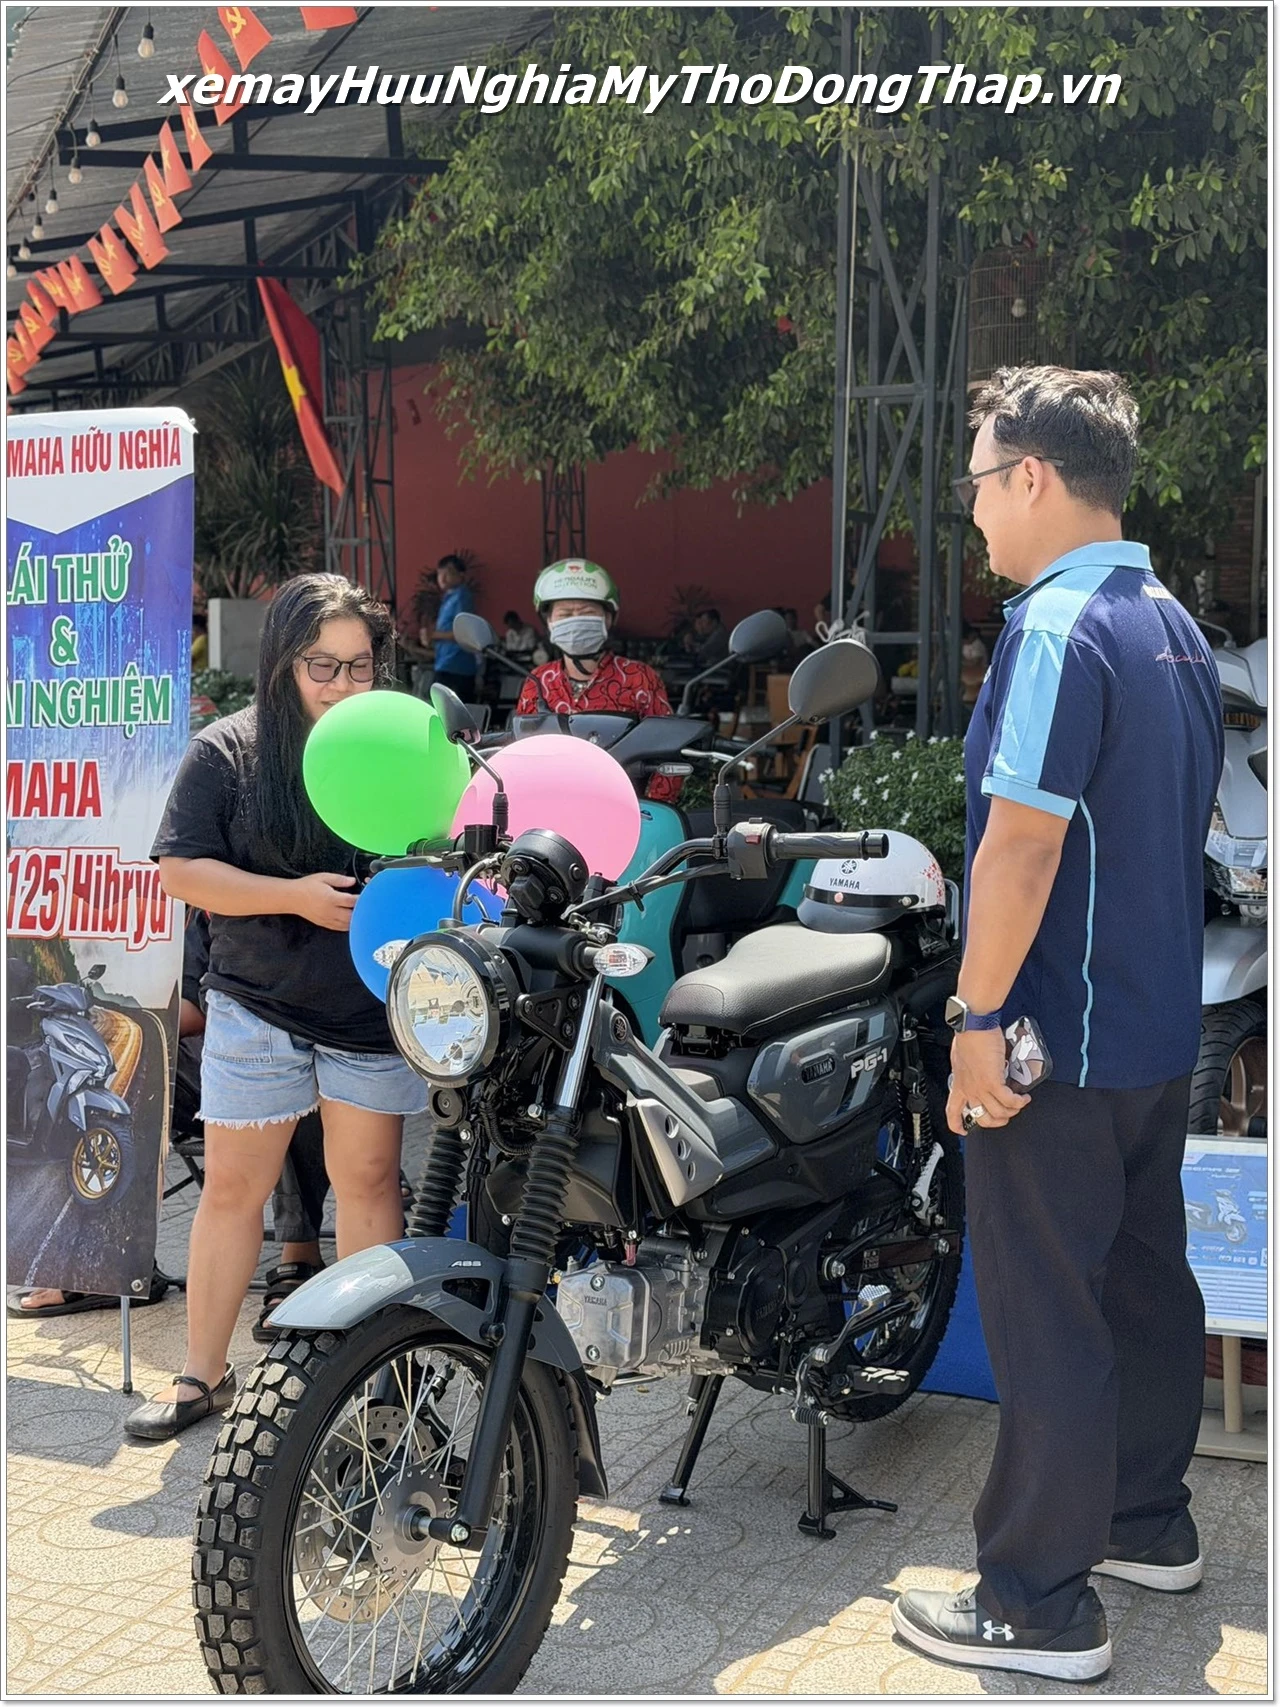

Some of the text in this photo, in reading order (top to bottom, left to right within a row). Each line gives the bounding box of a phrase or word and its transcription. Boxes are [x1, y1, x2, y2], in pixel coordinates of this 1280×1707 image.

[71, 425, 112, 474] HỮU
[118, 421, 181, 470] NGHĨA
[7, 534, 133, 604] ÁI THỬ
[51, 615, 78, 666] &
[31, 661, 172, 739] NGHIỆM
[7, 853, 61, 932] 125
[829, 877, 861, 890] YAMAHA
[850, 1048, 889, 1079] PG-1
